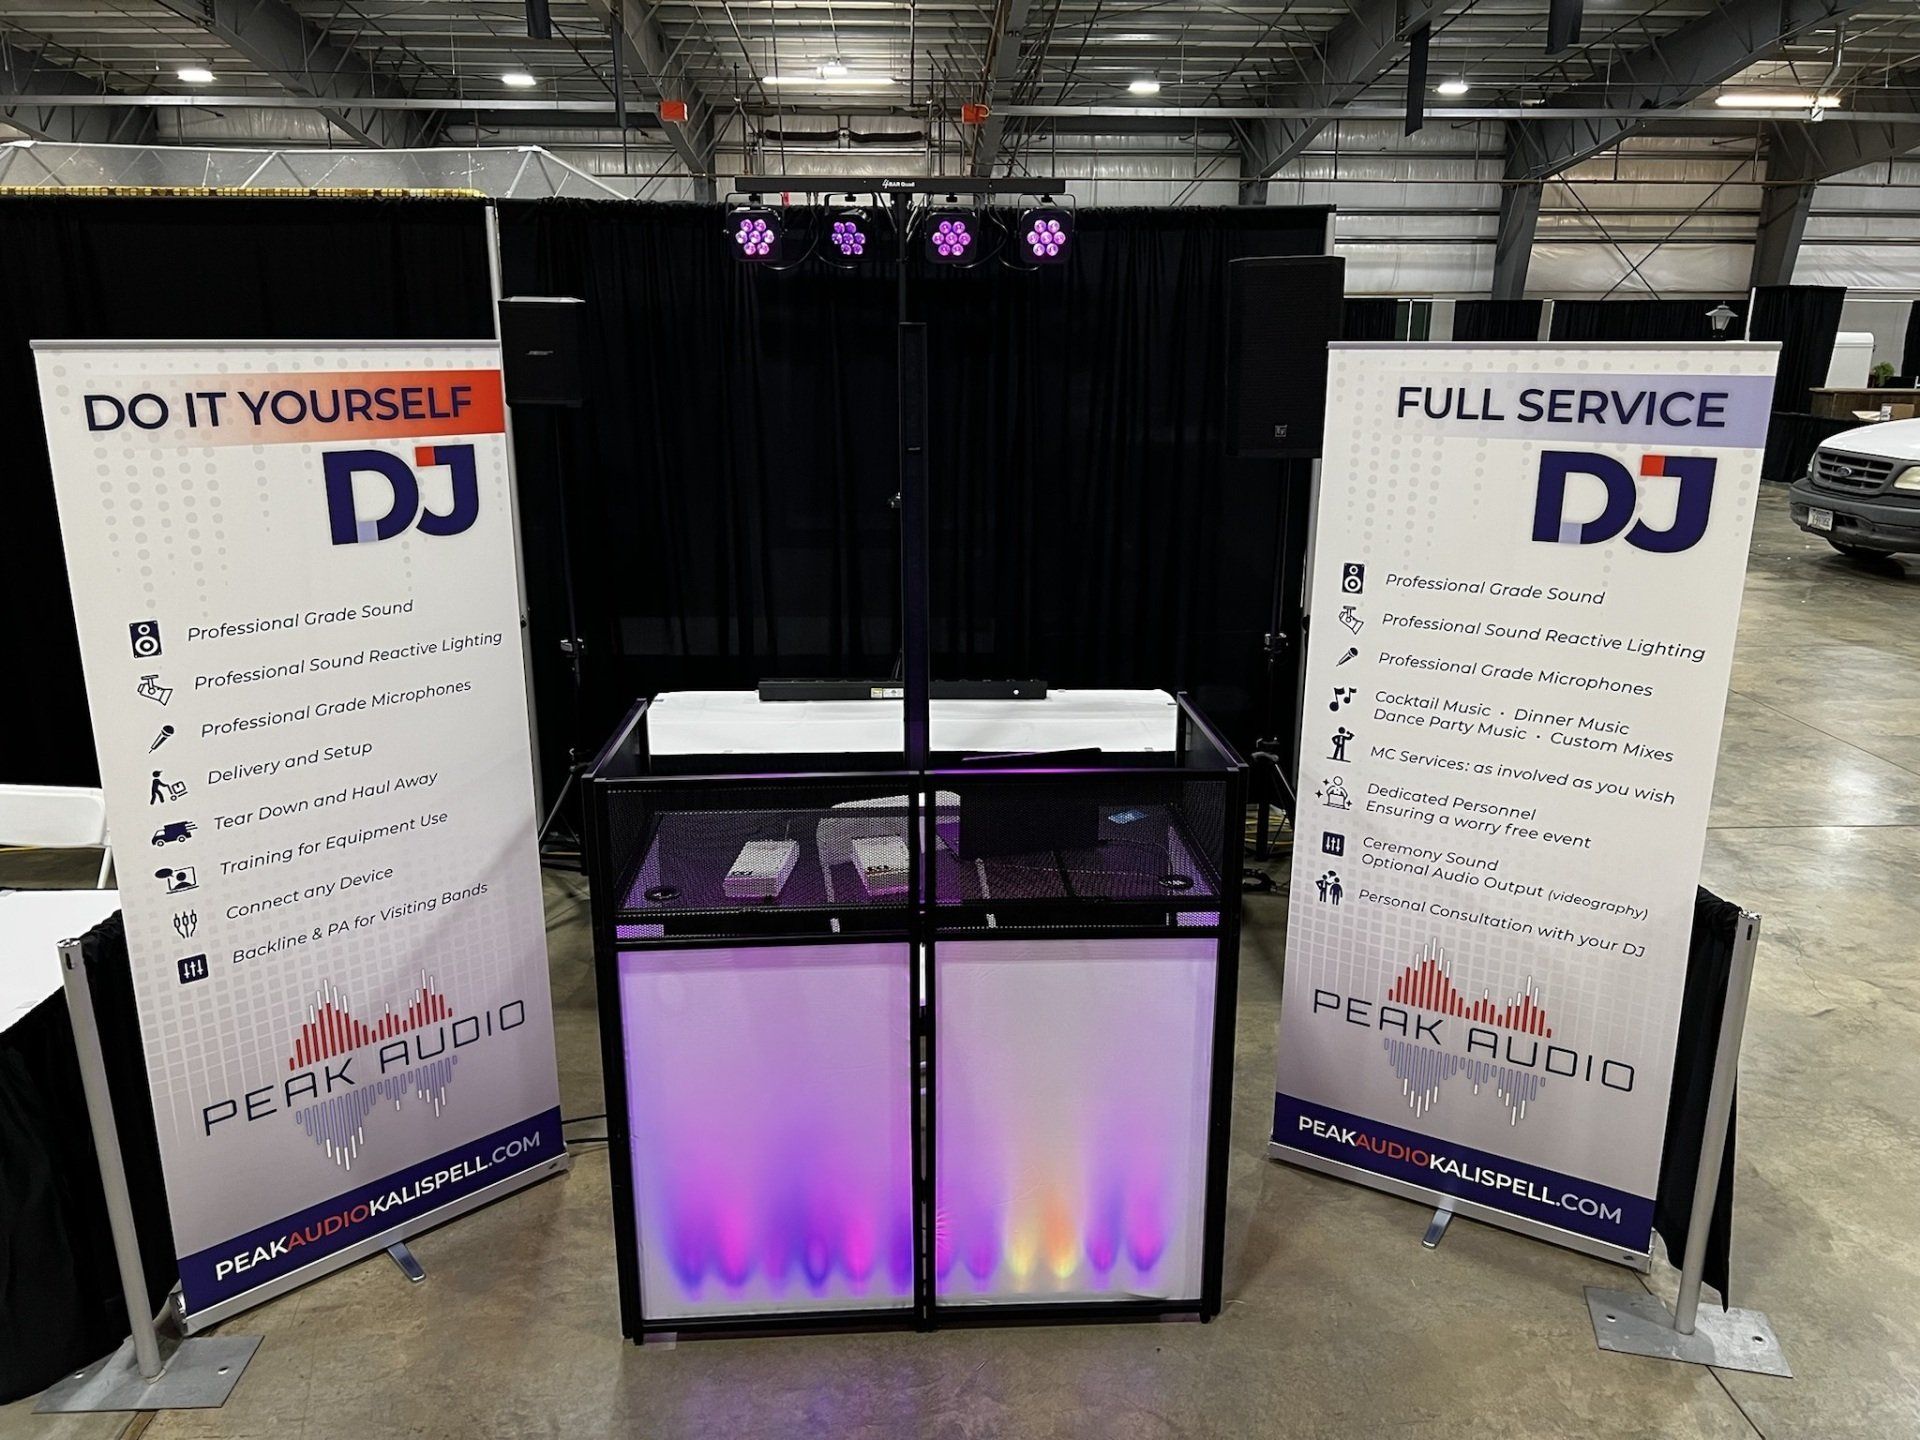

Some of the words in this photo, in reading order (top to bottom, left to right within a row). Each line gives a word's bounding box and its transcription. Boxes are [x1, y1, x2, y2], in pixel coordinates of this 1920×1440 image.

[83, 393, 170, 431] DO
[185, 392, 226, 428] IT
[237, 386, 471, 427] YOURSELF
[1397, 386, 1504, 421] FULL
[1517, 389, 1729, 427] SERVICE
[322, 444, 479, 545] DJ
[1532, 450, 1718, 553] DJ
[1385, 573, 1486, 595] Professional
[1489, 582, 1543, 599] Grade
[1546, 587, 1606, 605] Sound
[187, 612, 300, 642] Professional
[303, 606, 358, 626] Grade
[360, 598, 414, 619] Sound
[1381, 612, 1482, 635] Professional
[1483, 623, 1542, 641] Sound
[1544, 629, 1623, 650] Reactive
[1626, 637, 1706, 663] Lighting
[194, 659, 305, 691] Professional
[308, 650, 365, 672] Sound
[368, 642, 438, 663] Reactive
[441, 632, 503, 653] Lighting
[1378, 651, 1478, 675] Professional
[1480, 663, 1534, 682] Grade
[1537, 669, 1654, 697] Microphones
[201, 704, 311, 738] Professional
[314, 697, 367, 717] Grade
[371, 680, 472, 708] Microphones
[1373, 707, 1425, 727] Dance
[1428, 715, 1476, 736] Party
[1476, 721, 1528, 740] Music
[1550, 731, 1618, 753] Custom
[1622, 741, 1675, 763] Mixes
[1375, 690, 1440, 711] Cocktail
[1442, 699, 1492, 717] Music
[1513, 708, 1575, 728] Dinner
[1576, 716, 1630, 736] Music
[207, 760, 281, 785] Delivery
[284, 749, 319, 769] and
[323, 742, 373, 761] Setup
[1370, 745, 1397, 761] MC
[1398, 750, 1471, 772] Services:
[1473, 763, 1494, 775] as
[1496, 763, 1570, 786] involved
[1572, 778, 1594, 790] as
[1594, 781, 1630, 796] you
[1634, 787, 1676, 806] wish
[213, 812, 254, 831] Tear
[258, 800, 309, 821] Down
[313, 788, 348, 808] and
[351, 779, 391, 801] Haul
[393, 772, 438, 792] Away
[1366, 800, 1435, 825] Ensuring
[1438, 814, 1451, 825] a
[1454, 816, 1503, 836] worry
[1504, 822, 1539, 840] free
[1542, 831, 1592, 849] event
[1367, 783, 1448, 807] Dedicated
[1452, 796, 1537, 821] Personnel
[219, 848, 294, 876] Training
[297, 841, 322, 857] for
[325, 818, 416, 851] Equipment
[420, 812, 448, 828] Use
[1363, 837, 1442, 864] Ceremony
[1446, 852, 1499, 871] Sound
[225, 890, 300, 920] Connect
[303, 882, 336, 899] any
[339, 868, 394, 890] Device
[1361, 854, 1429, 876] Optional
[1430, 864, 1480, 886] Audio
[1483, 876, 1545, 898] Output
[1547, 889, 1649, 922] (videography)
[232, 934, 308, 964] Backline
[311, 927, 323, 941] &
[327, 919, 350, 937] PA
[353, 914, 377, 929] for
[379, 897, 437, 922] Visiting
[441, 882, 488, 905] Bands
[1358, 888, 1427, 913] Personal
[1429, 903, 1533, 934] Consultation
[1537, 926, 1575, 943] with
[1576, 934, 1619, 951] your
[1621, 942, 1646, 958] DJ
[202, 1058, 355, 1136] PEAK
[380, 1000, 525, 1073] AUDIO
[1313, 989, 1443, 1045] PEAK
[1467, 1027, 1634, 1092] AUDIO
[1299, 1116, 1622, 1224] PEAKAUDIOKALISPELL.COM
[215, 1131, 541, 1281] PEAKAUDIOKALISPELL.COM
